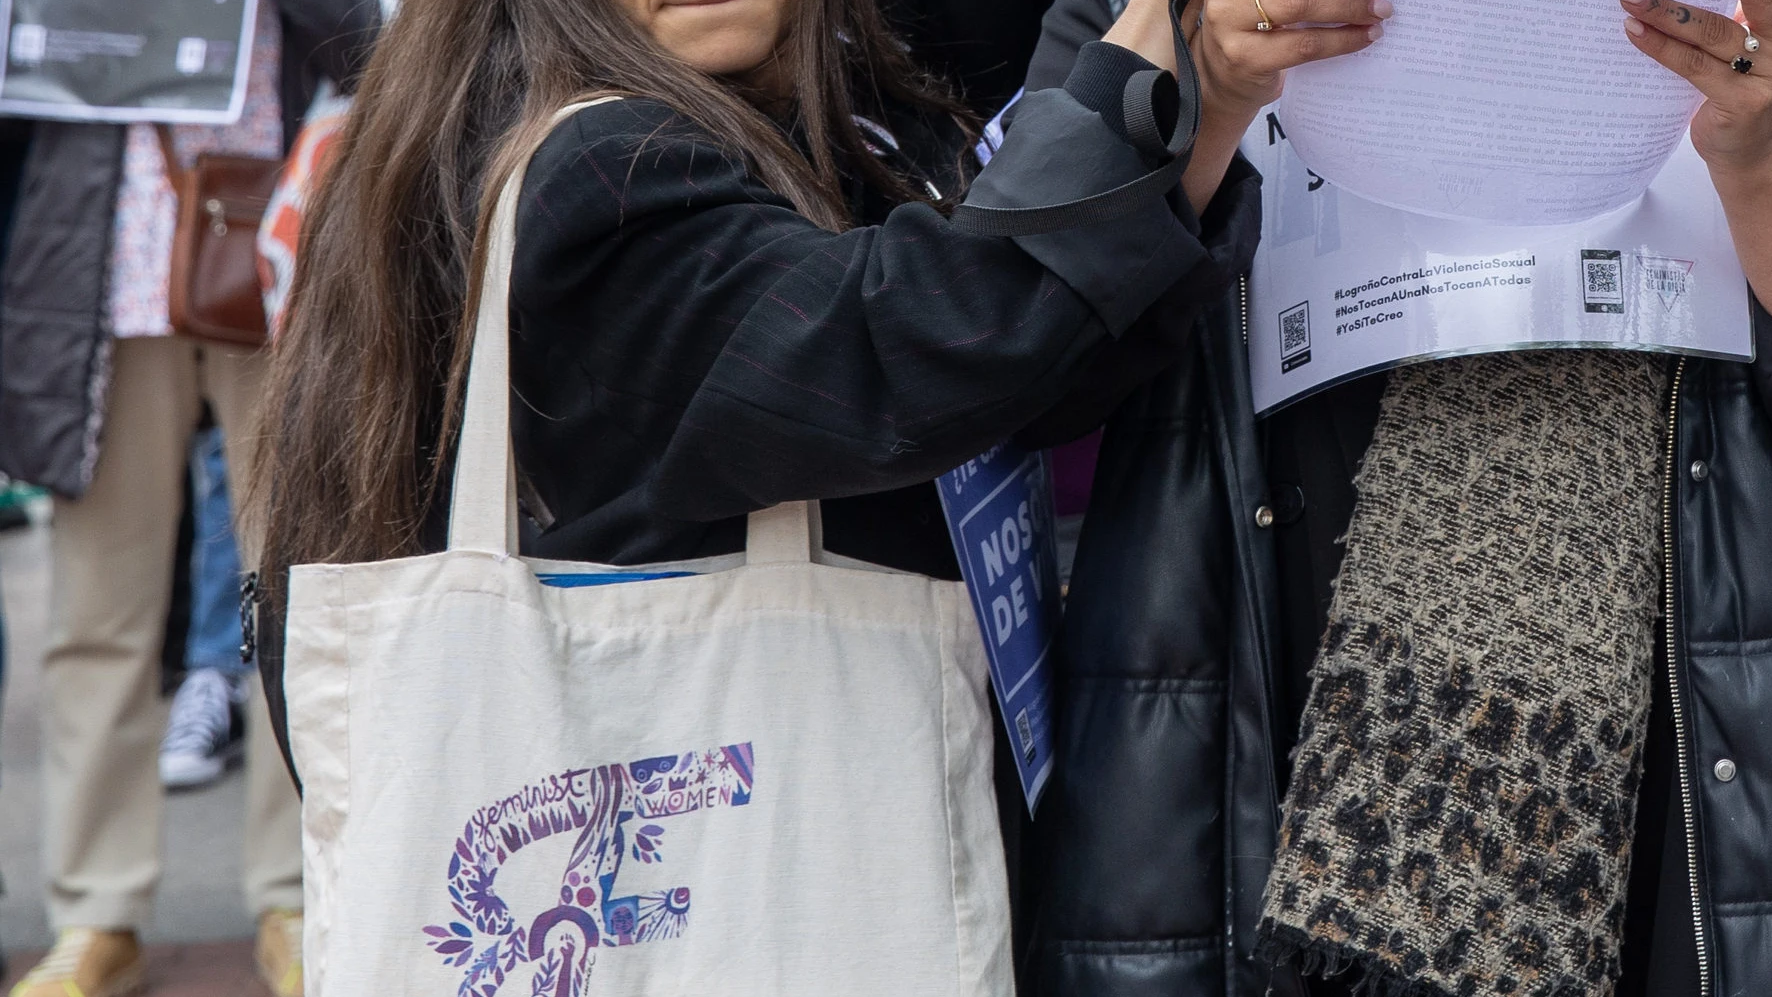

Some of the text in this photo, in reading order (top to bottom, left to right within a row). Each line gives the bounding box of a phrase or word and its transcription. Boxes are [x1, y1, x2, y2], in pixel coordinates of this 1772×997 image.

[1334, 255, 1536, 301] #LogroñoContraLaViolenciaSexual
[1335, 274, 1532, 318] #NosTocanAUnaNosTocanATodas
[991, 575, 1029, 647] DE
[472, 768, 592, 853] feminist
[645, 785, 730, 816] WOMEN
